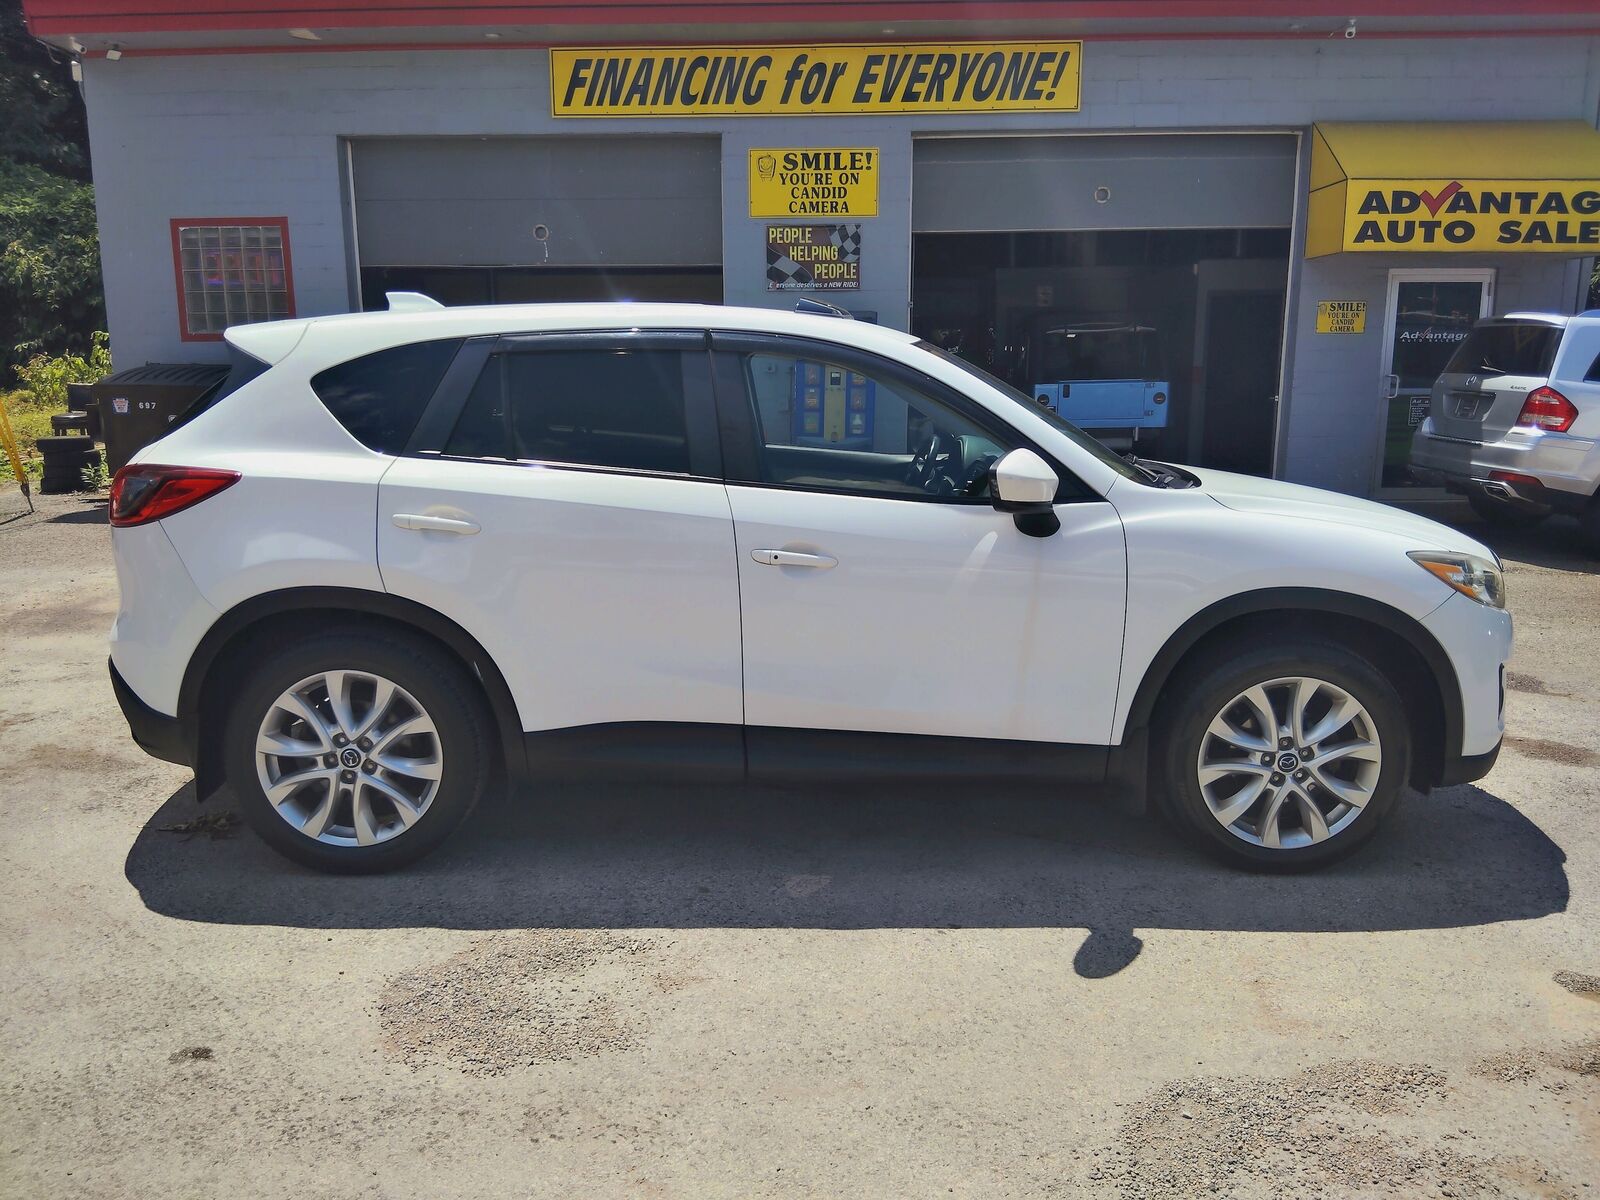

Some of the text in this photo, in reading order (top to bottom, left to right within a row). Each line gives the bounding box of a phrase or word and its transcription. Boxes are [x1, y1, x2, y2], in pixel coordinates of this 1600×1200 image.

[562, 50, 1071, 107] FINANCING for EVERYONE!
[782, 152, 872, 171] SMILE!
[779, 172, 860, 186] YOU'RE ON
[790, 186, 848, 199] CANDID
[788, 200, 850, 214] CAMERA
[768, 227, 813, 244] PEOPLE
[1352, 220, 1476, 244] AUTO
[789, 245, 839, 261] HELPING
[814, 263, 857, 279] PEOPLE
[1329, 302, 1366, 312] SMILE!
